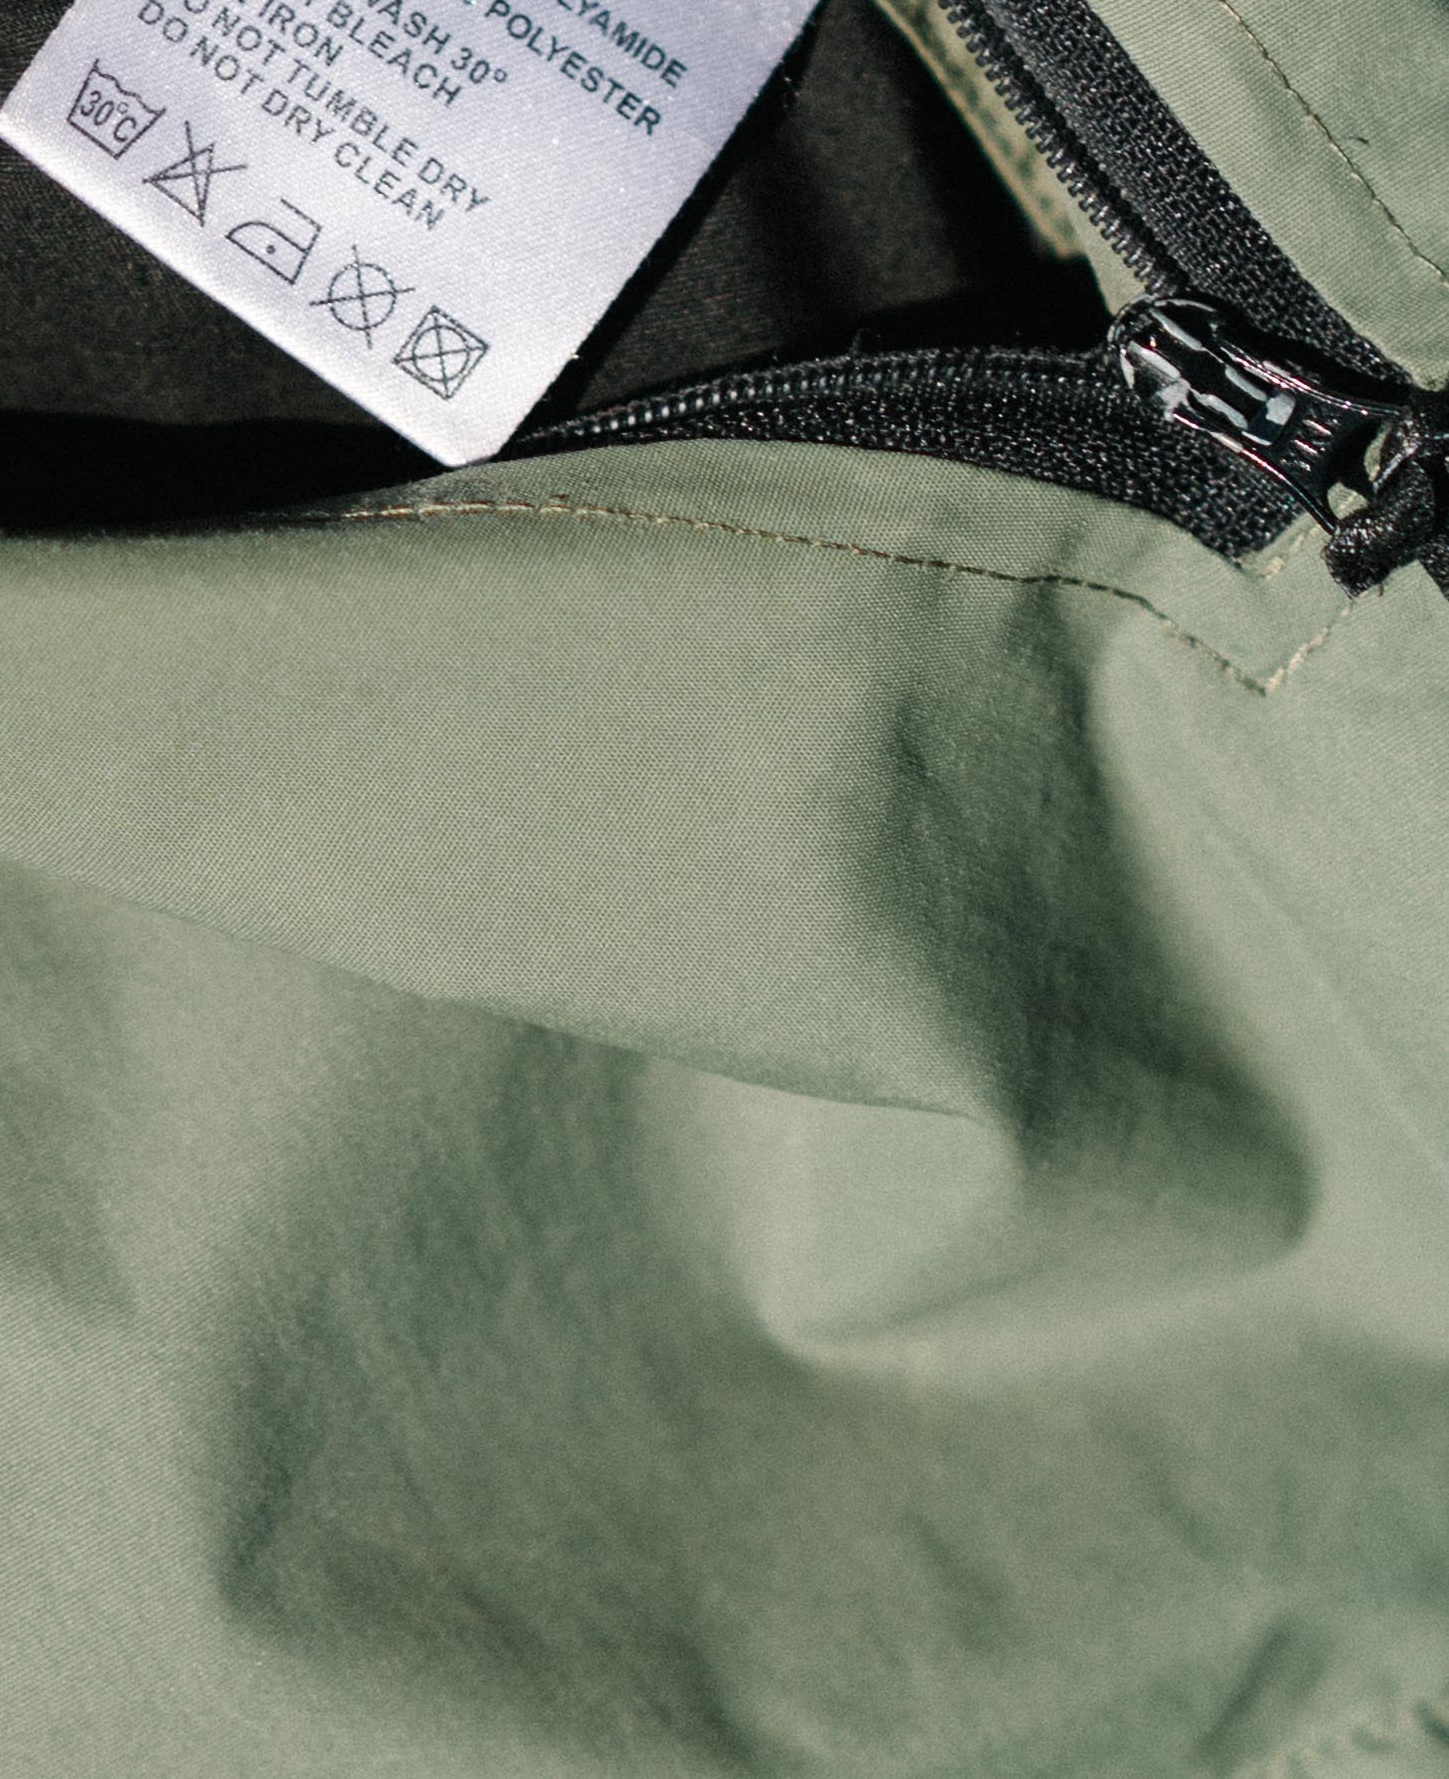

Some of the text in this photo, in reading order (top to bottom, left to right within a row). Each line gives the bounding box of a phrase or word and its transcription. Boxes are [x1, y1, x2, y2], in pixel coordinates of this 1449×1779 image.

[189, 35, 264, 95] NOT
[261, 88, 336, 144] DRY
[334, 142, 446, 231] CLEAN
[212, 6, 286, 66] NOT
[287, 58, 419, 168] TUMBLE
[417, 157, 490, 212] DRY
[327, 0, 462, 108] BLEACH
